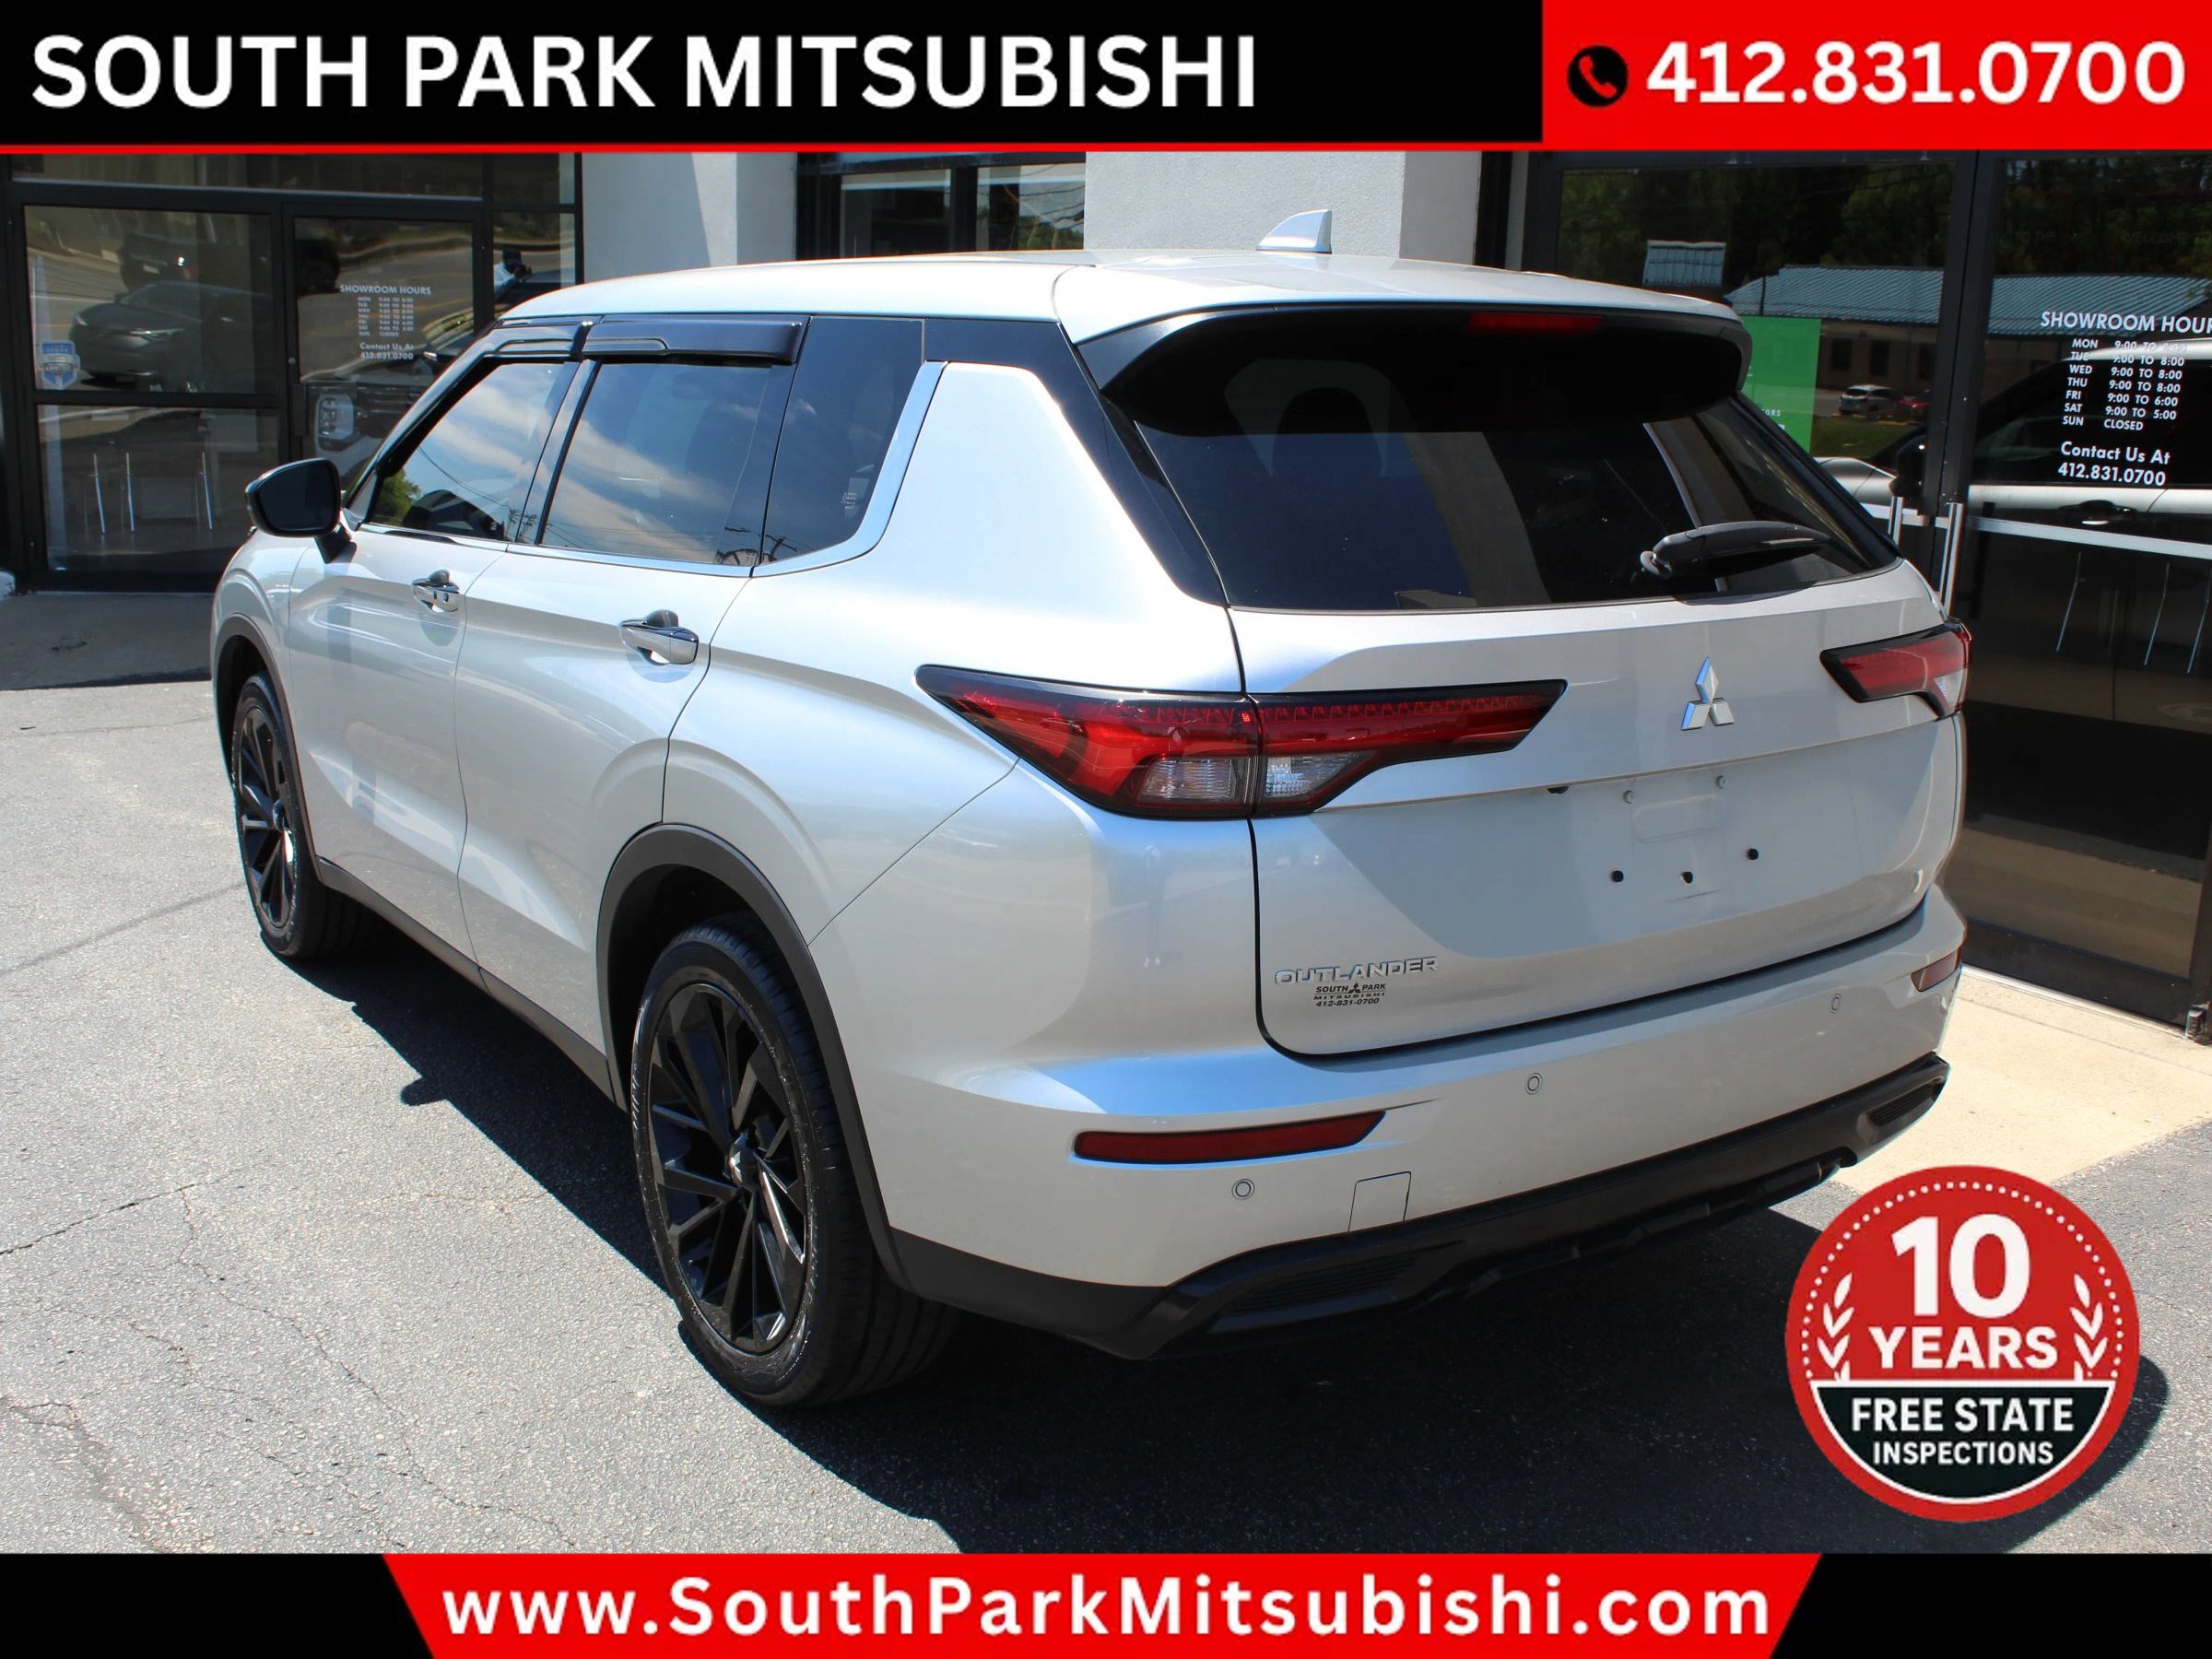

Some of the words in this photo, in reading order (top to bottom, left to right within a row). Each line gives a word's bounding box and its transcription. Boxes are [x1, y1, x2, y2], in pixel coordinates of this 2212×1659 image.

[339, 284, 398, 294] SHOWROOM
[400, 286, 432, 295] HOURS
[2040, 311, 2156, 332] SHOWROOM
[359, 342, 390, 350] Contact
[2072, 338, 2099, 348] MON
[2114, 340, 2137, 350] 9:00
[2142, 342, 2157, 352] TO
[2070, 351, 2089, 361] TUE
[2112, 354, 2135, 364] 9:00
[2140, 355, 2154, 365] TO
[2160, 357, 2184, 367] 8:00
[2069, 364, 2092, 374] WED
[2111, 367, 2134, 377] 9:00
[2138, 368, 2153, 379] TO
[2158, 370, 2183, 380] 8:00
[2067, 377, 2088, 387] THU
[2109, 380, 2132, 390] 9:00
[2136, 382, 2151, 392] TO
[2156, 382, 2181, 394] 8:00
[2065, 390, 2081, 400] FRI
[2107, 393, 2130, 404] 9:00
[2135, 394, 2149, 405] TO
[2154, 396, 2179, 406] 6:00
[2064, 403, 2083, 413] SAT
[2105, 406, 2128, 417] 9:00
[2132, 407, 2146, 418] TO
[2153, 409, 2177, 420] 5:00
[2062, 415, 2084, 426] SUN
[2103, 418, 2144, 431] CLOSED
[2061, 441, 2121, 460] Contact
[2125, 446, 2146, 462] Us
[2150, 449, 2171, 465] At
[2057, 462, 2166, 487] 412.831.0700
[1275, 956, 1438, 985] OUTLANDER
[1361, 982, 1386, 991] PARK
[1313, 992, 1385, 1000] MITSUBISHI
[1315, 997, 1380, 1007] 412-831-0700
